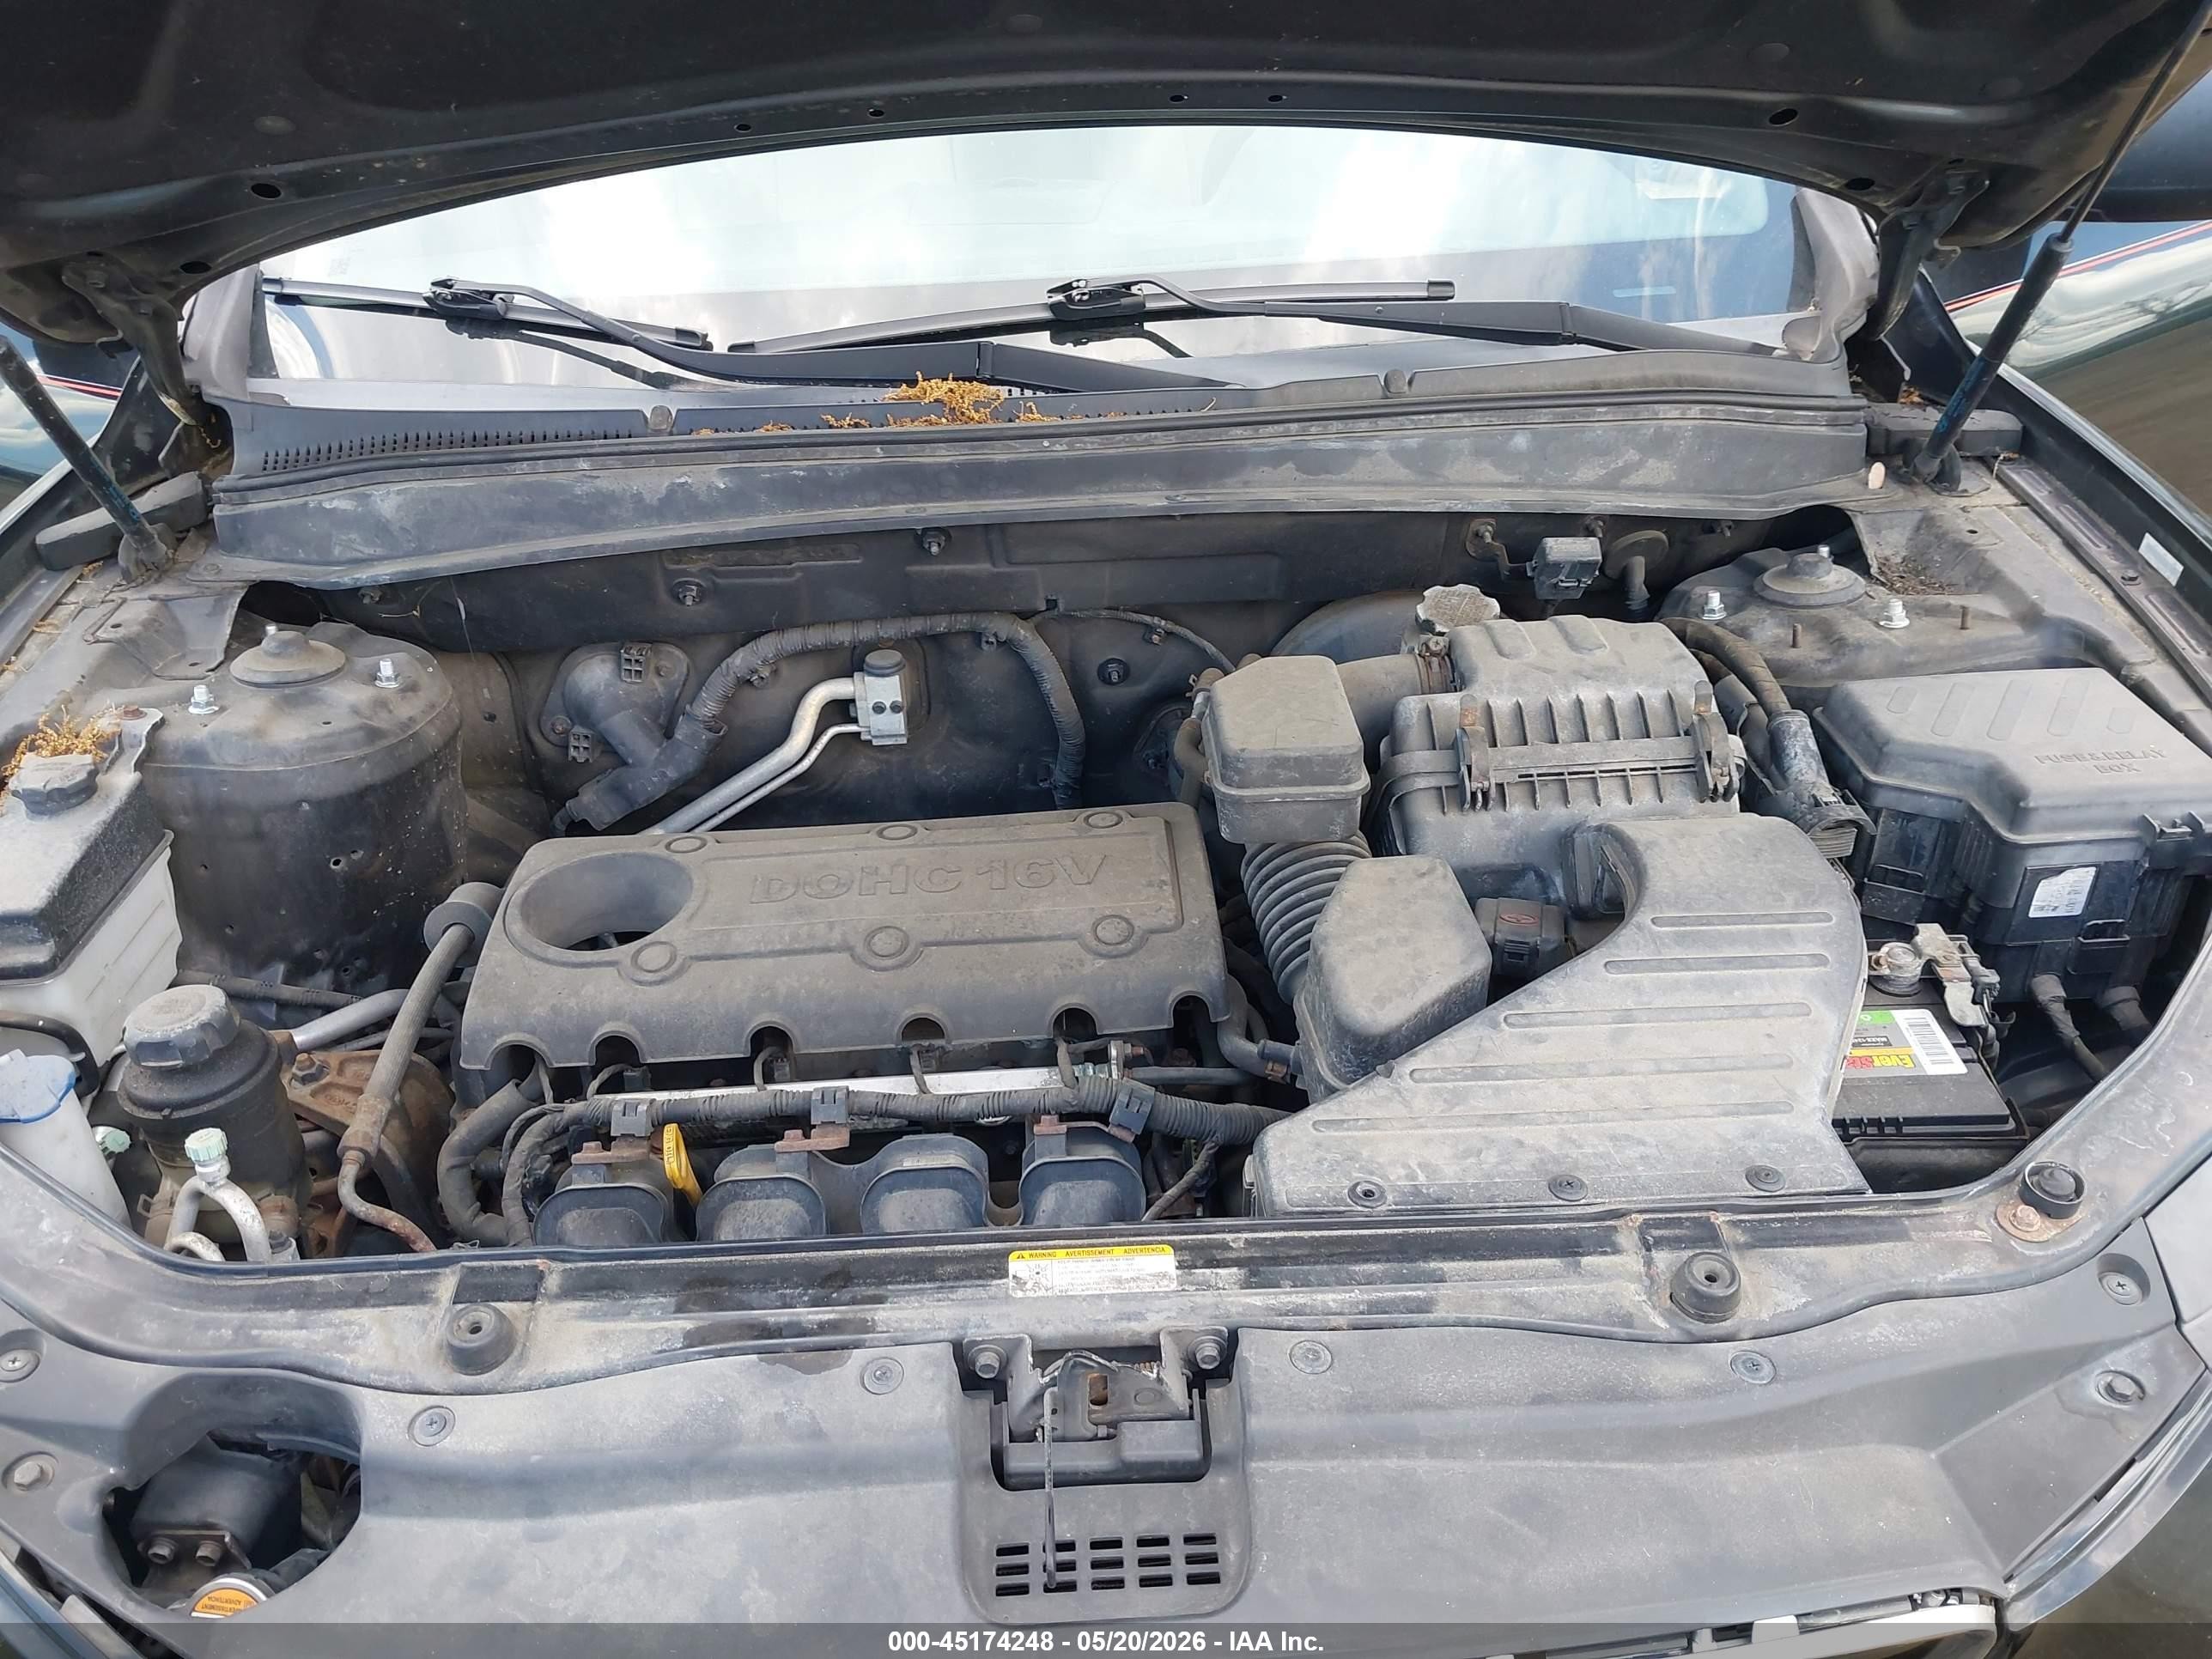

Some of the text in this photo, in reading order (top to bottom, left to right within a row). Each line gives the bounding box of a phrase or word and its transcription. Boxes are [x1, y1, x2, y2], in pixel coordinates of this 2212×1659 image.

[2094, 763, 2142, 774] BOX
[750, 854, 1106, 904] DOHC 16V
